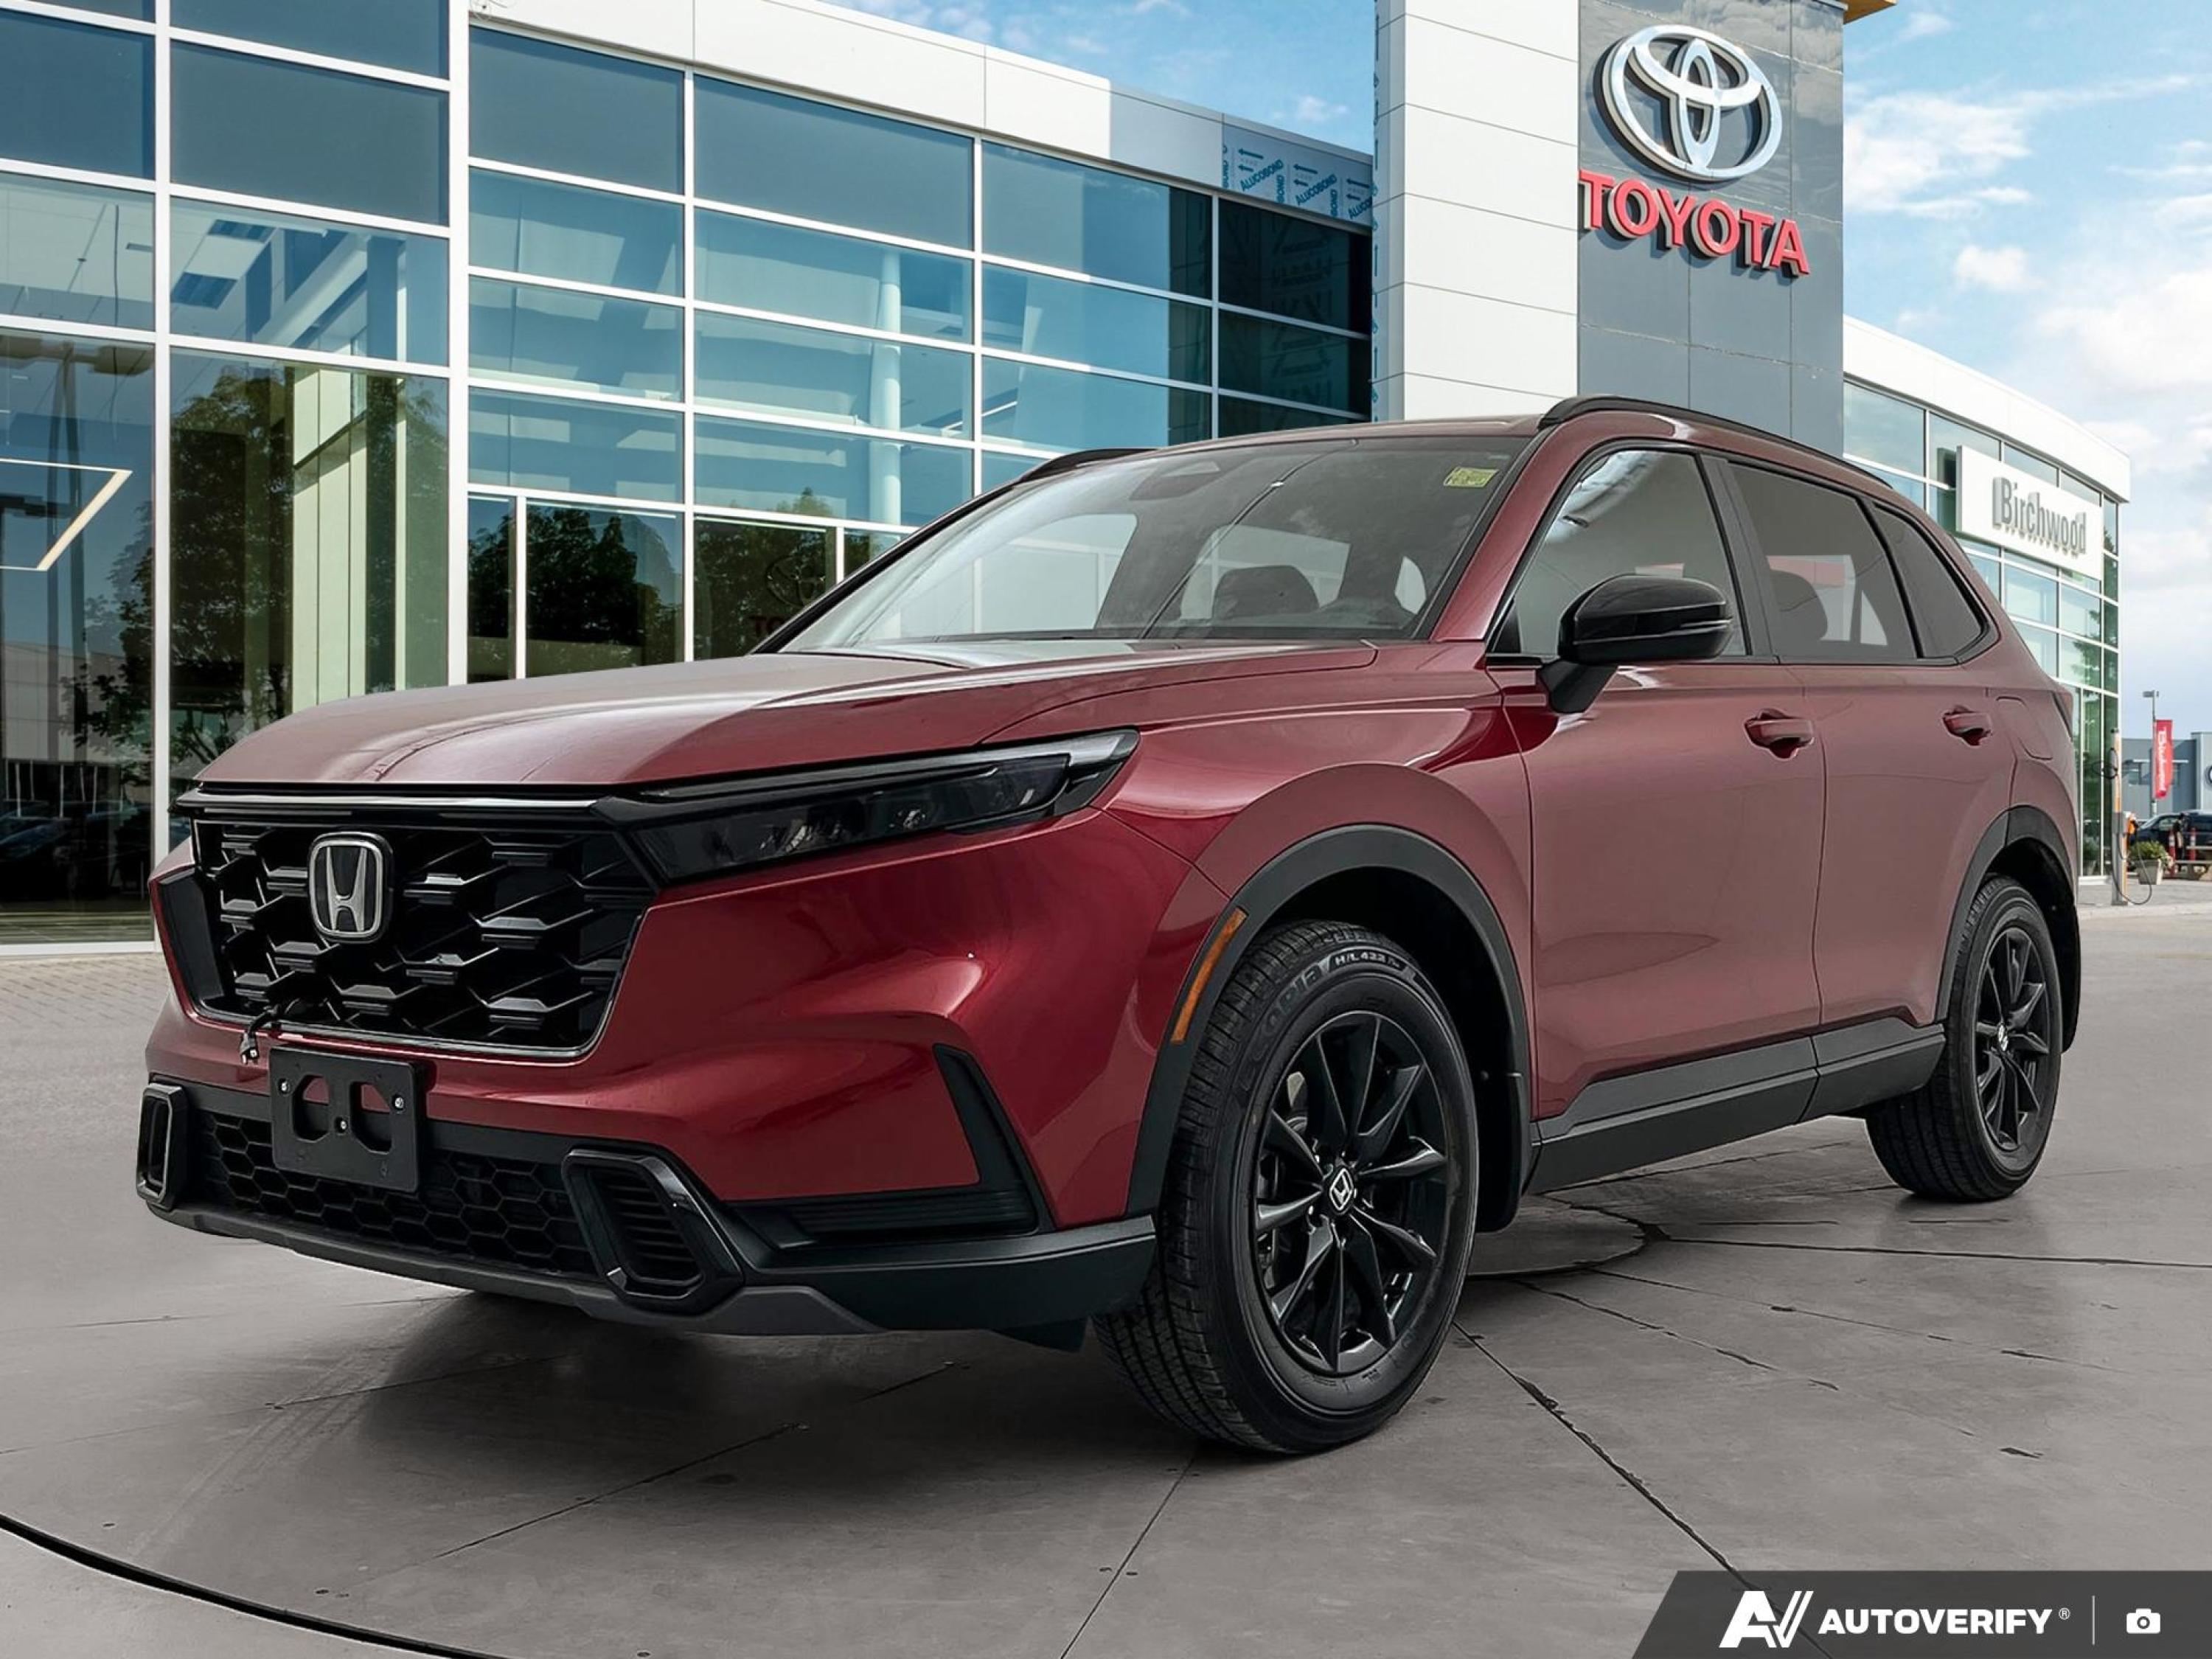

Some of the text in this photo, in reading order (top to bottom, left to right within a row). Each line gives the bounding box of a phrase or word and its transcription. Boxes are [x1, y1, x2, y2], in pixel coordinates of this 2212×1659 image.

[1240, 159, 1284, 192] ALUCOBOND
[1296, 174, 1338, 206] ALUCOBOND
[1579, 170, 1809, 275] TOYOTA
[1994, 476, 2087, 556] Birchwood
